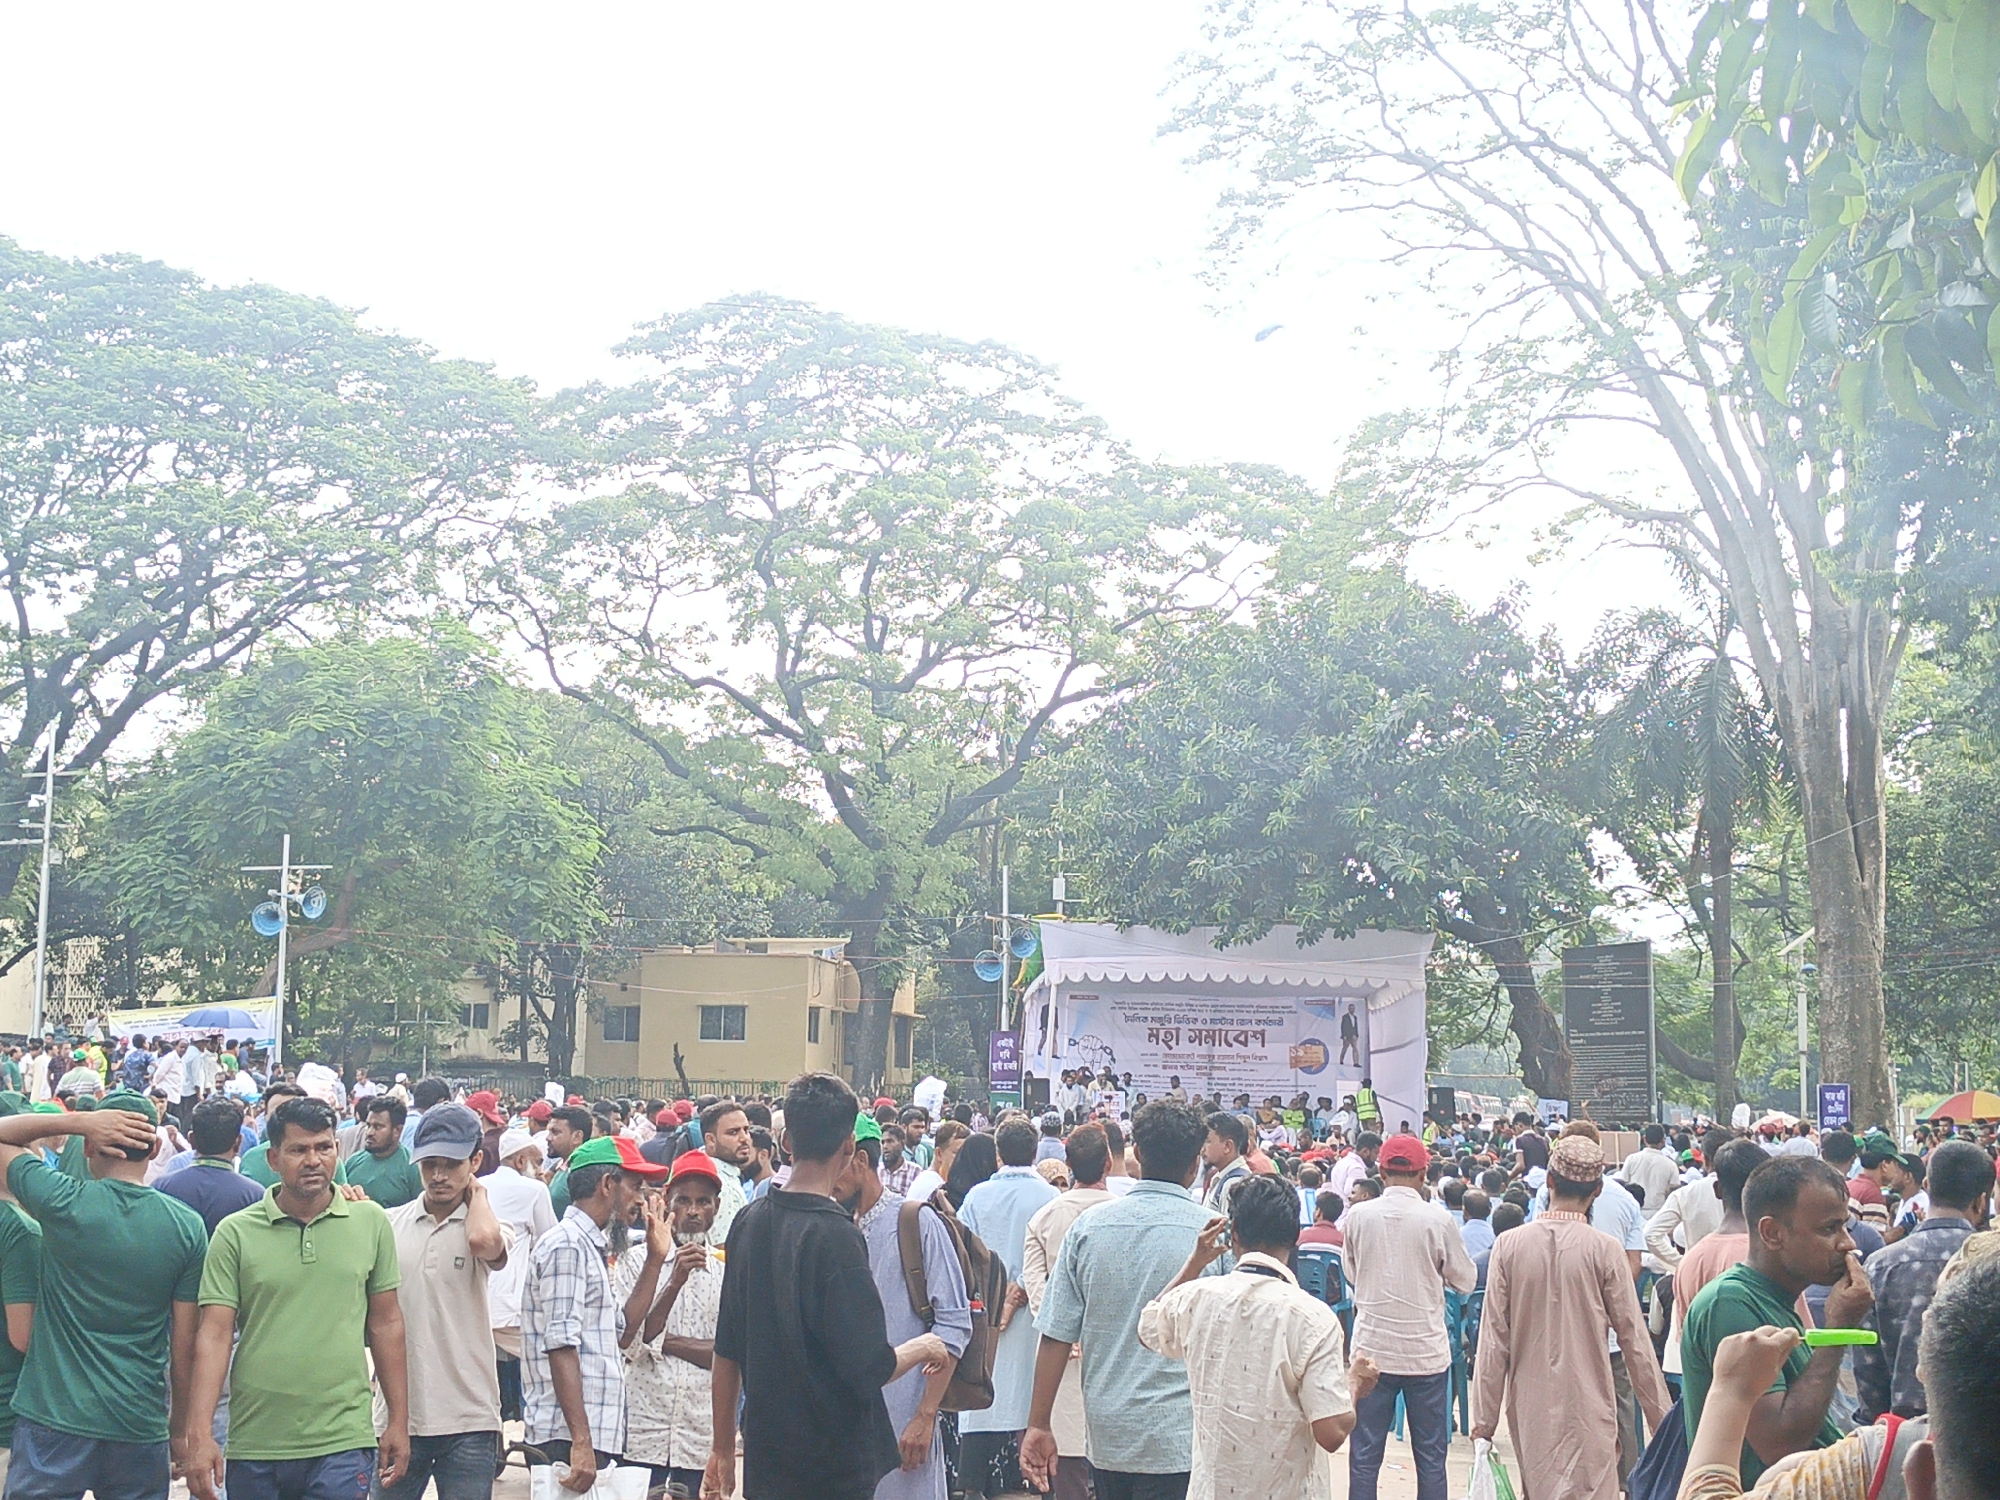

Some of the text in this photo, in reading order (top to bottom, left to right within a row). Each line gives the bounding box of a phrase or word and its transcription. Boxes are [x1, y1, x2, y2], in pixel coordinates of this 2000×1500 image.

[1123, 1012, 1148, 1023] দৈনিক
[1147, 1026, 1266, 1051] মহা সমাবেশ
